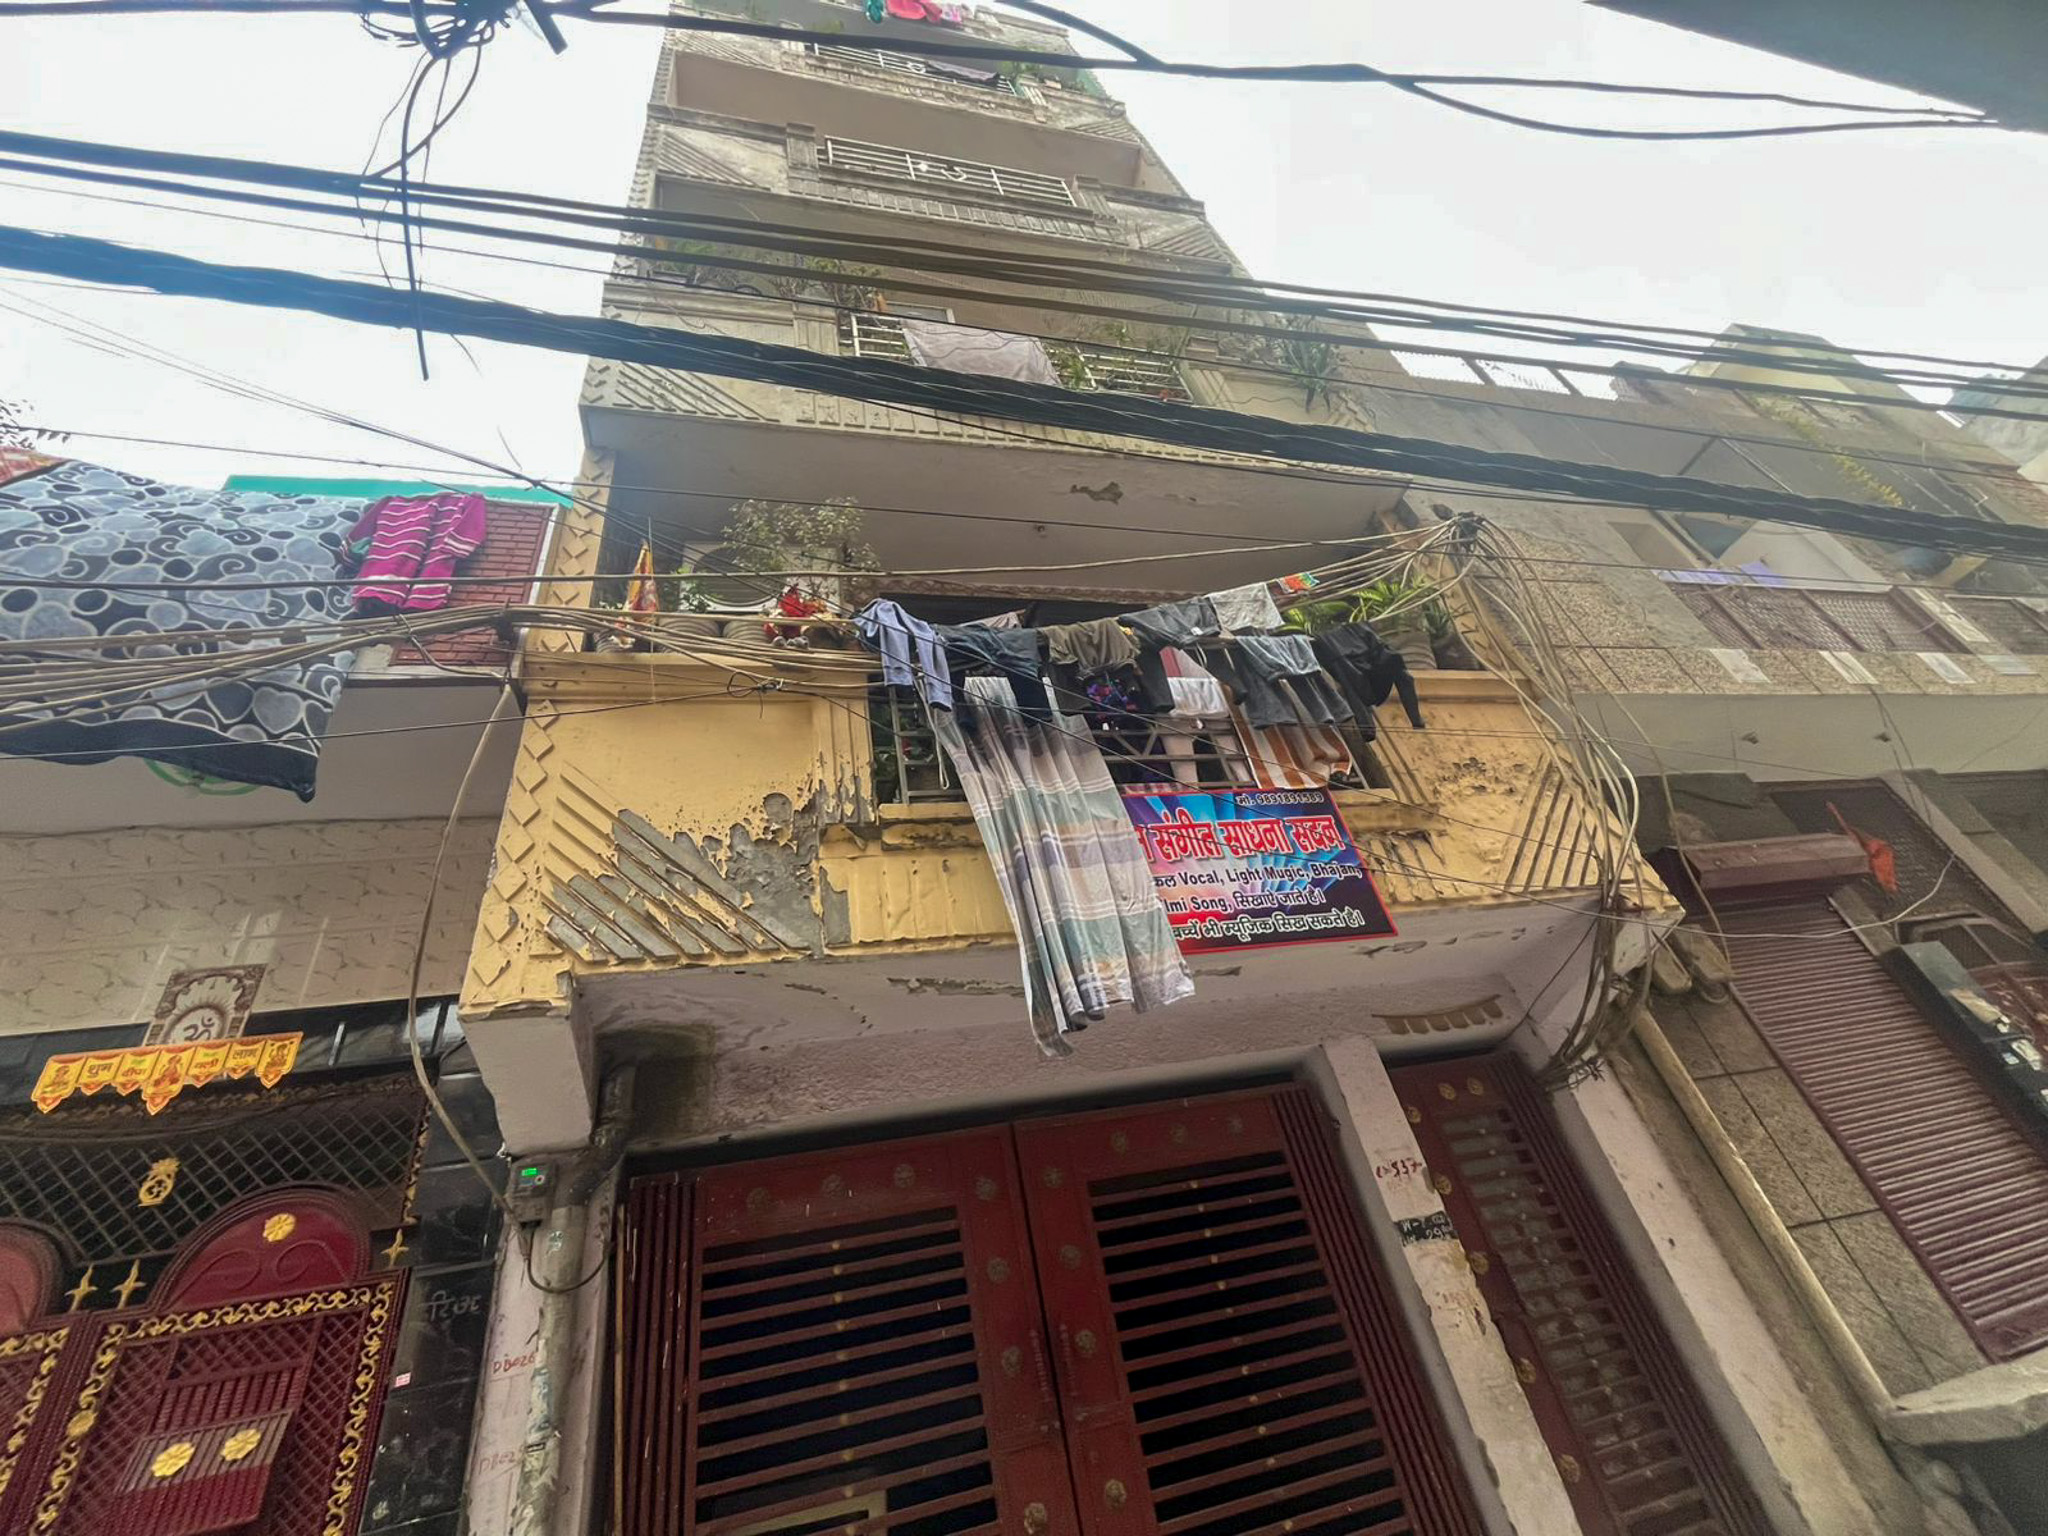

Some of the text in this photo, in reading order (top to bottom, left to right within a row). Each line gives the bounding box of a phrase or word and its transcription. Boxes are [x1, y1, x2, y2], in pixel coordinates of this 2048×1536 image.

[1149, 808, 1224, 862] संगीत
[1217, 819, 1293, 858] साधना
[1284, 815, 1346, 854] सदन
[1178, 869, 1225, 886] Vocal,
[1225, 867, 1262, 886] Light
[1310, 861, 1362, 879] Bhajan,
[1190, 896, 1233, 914] Song,
[1201, 918, 1222, 937] भी
